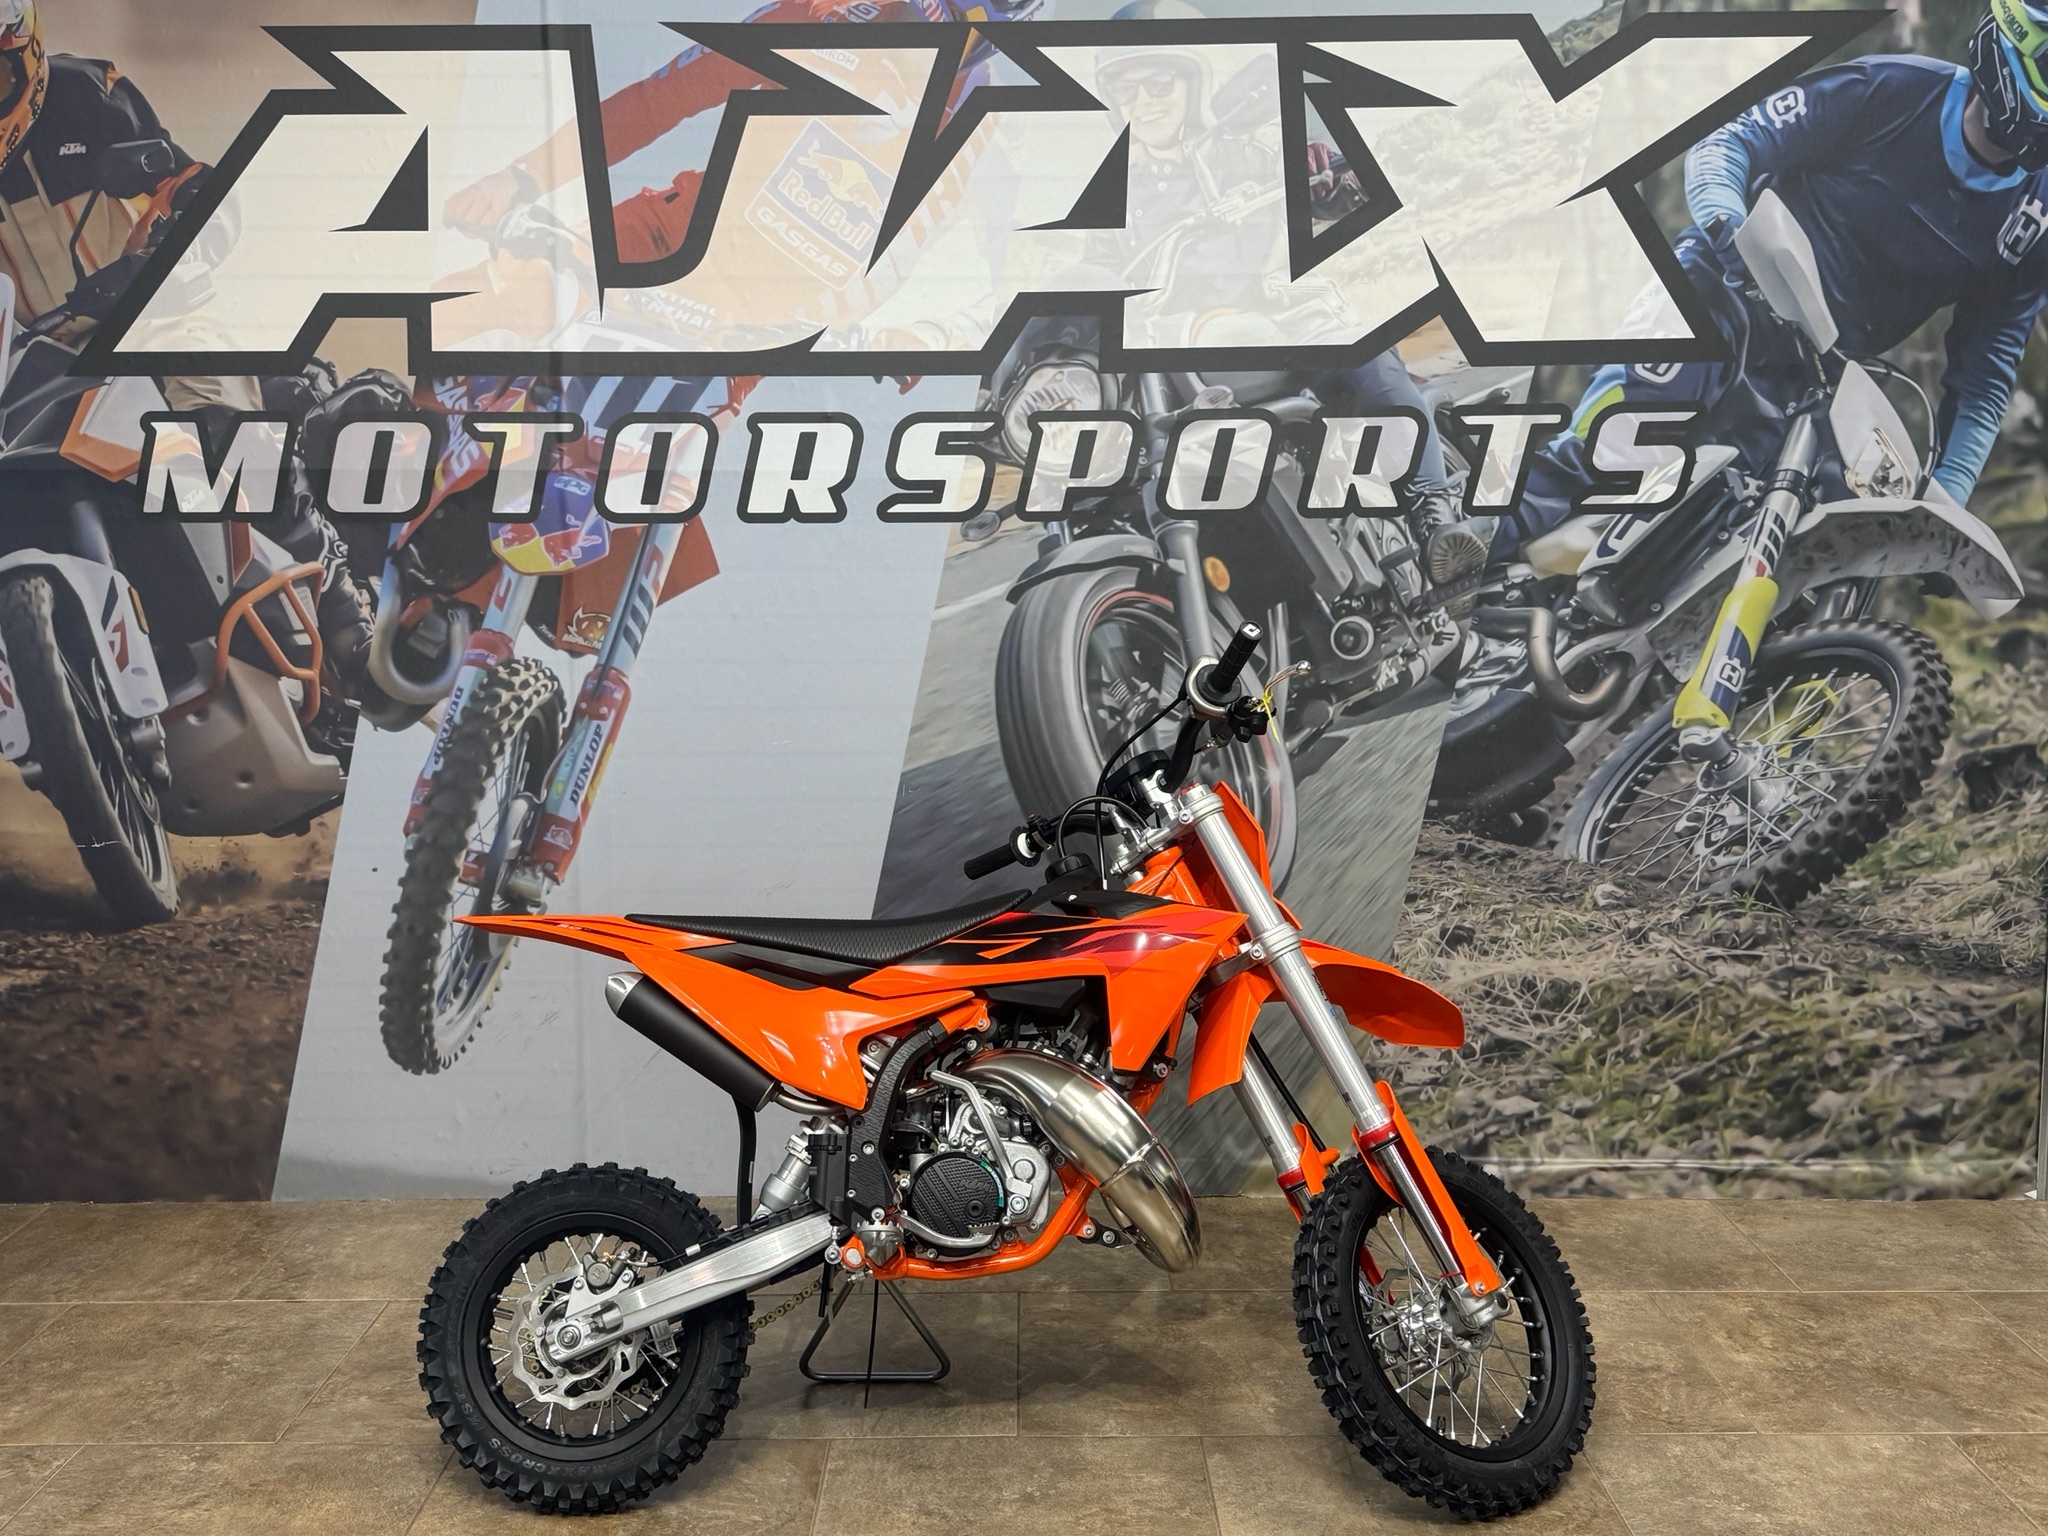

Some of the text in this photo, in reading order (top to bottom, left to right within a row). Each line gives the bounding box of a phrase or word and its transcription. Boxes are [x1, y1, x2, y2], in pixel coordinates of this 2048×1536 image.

[59, 142, 87, 156] KTM
[66, 12, 1895, 377] AJAX
[777, 168, 876, 251] Red Bull
[756, 206, 848, 277] GASGAS
[139, 407, 1705, 523] MOTORSPORTS
[569, 723, 604, 807] DUNLOP
